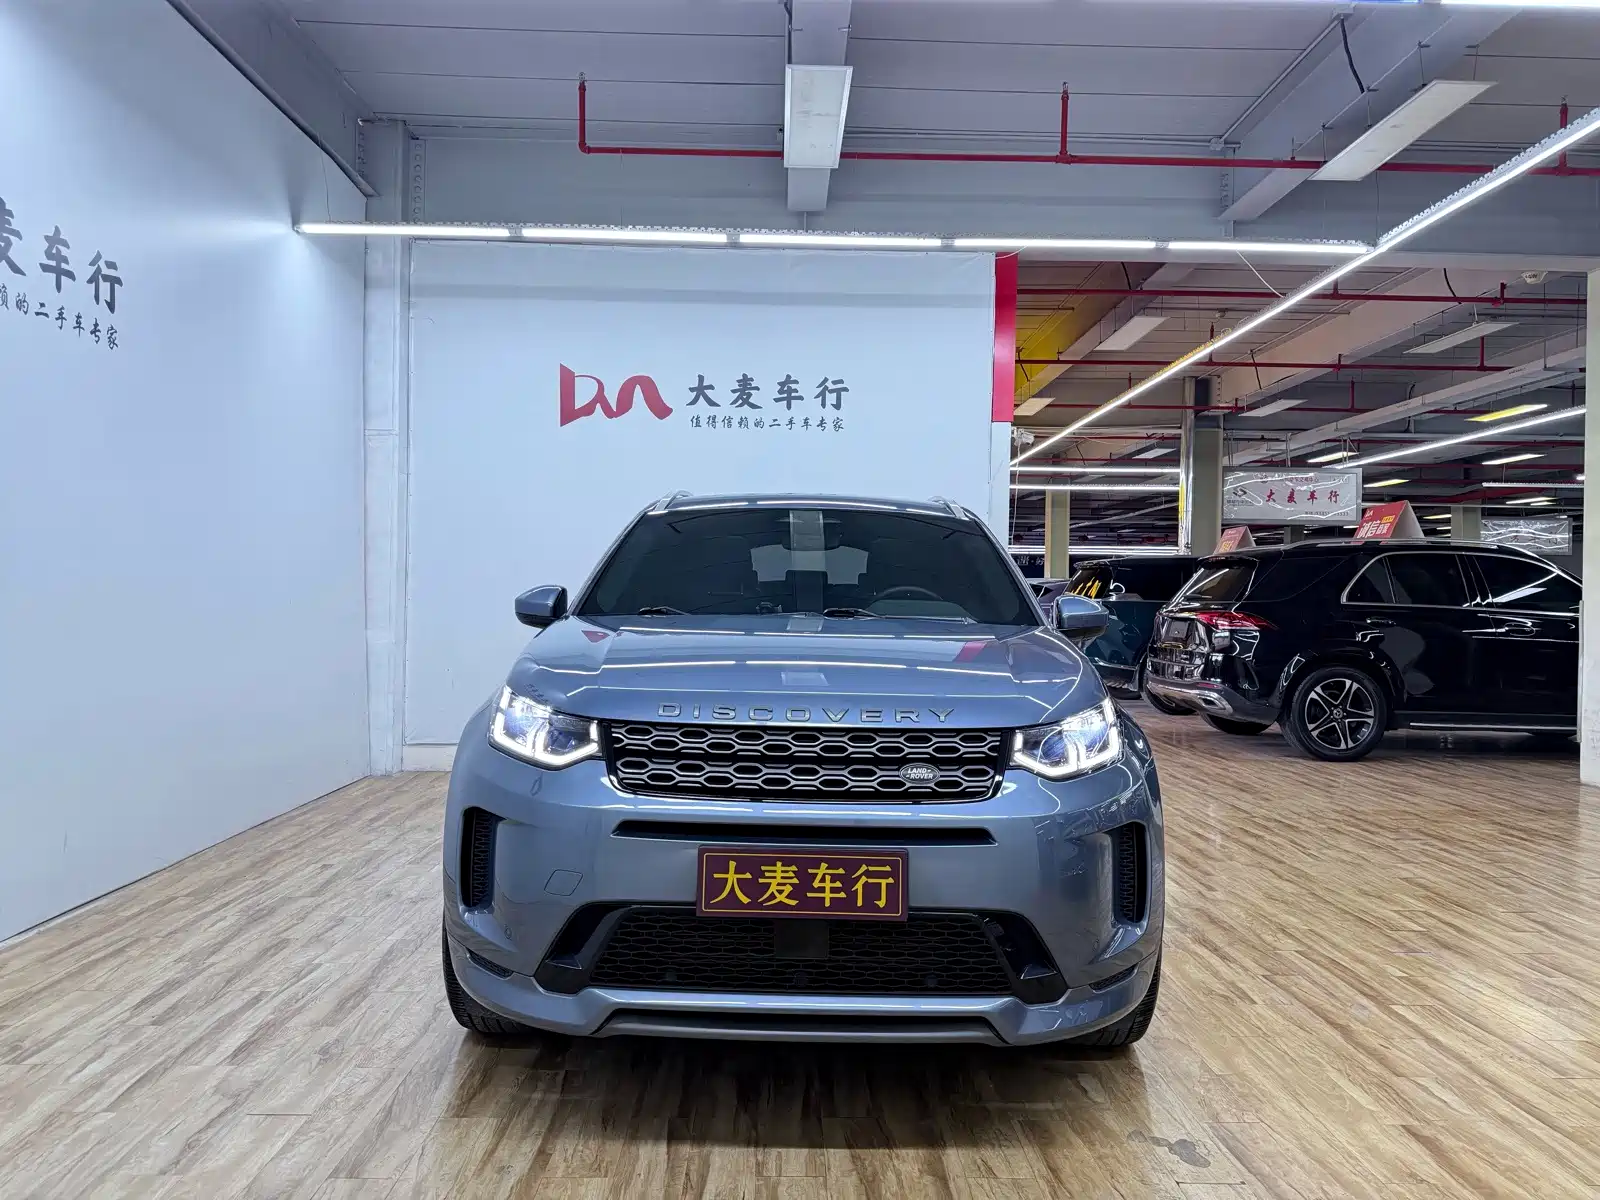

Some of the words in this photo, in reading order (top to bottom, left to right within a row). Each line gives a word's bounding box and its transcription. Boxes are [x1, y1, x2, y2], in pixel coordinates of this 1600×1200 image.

[685, 373, 850, 411] 大麦车行
[690, 415, 845, 432] 值得信赖的二手车专家
[657, 702, 955, 724] DISCOVERY
[710, 860, 895, 908] 大麦车行
